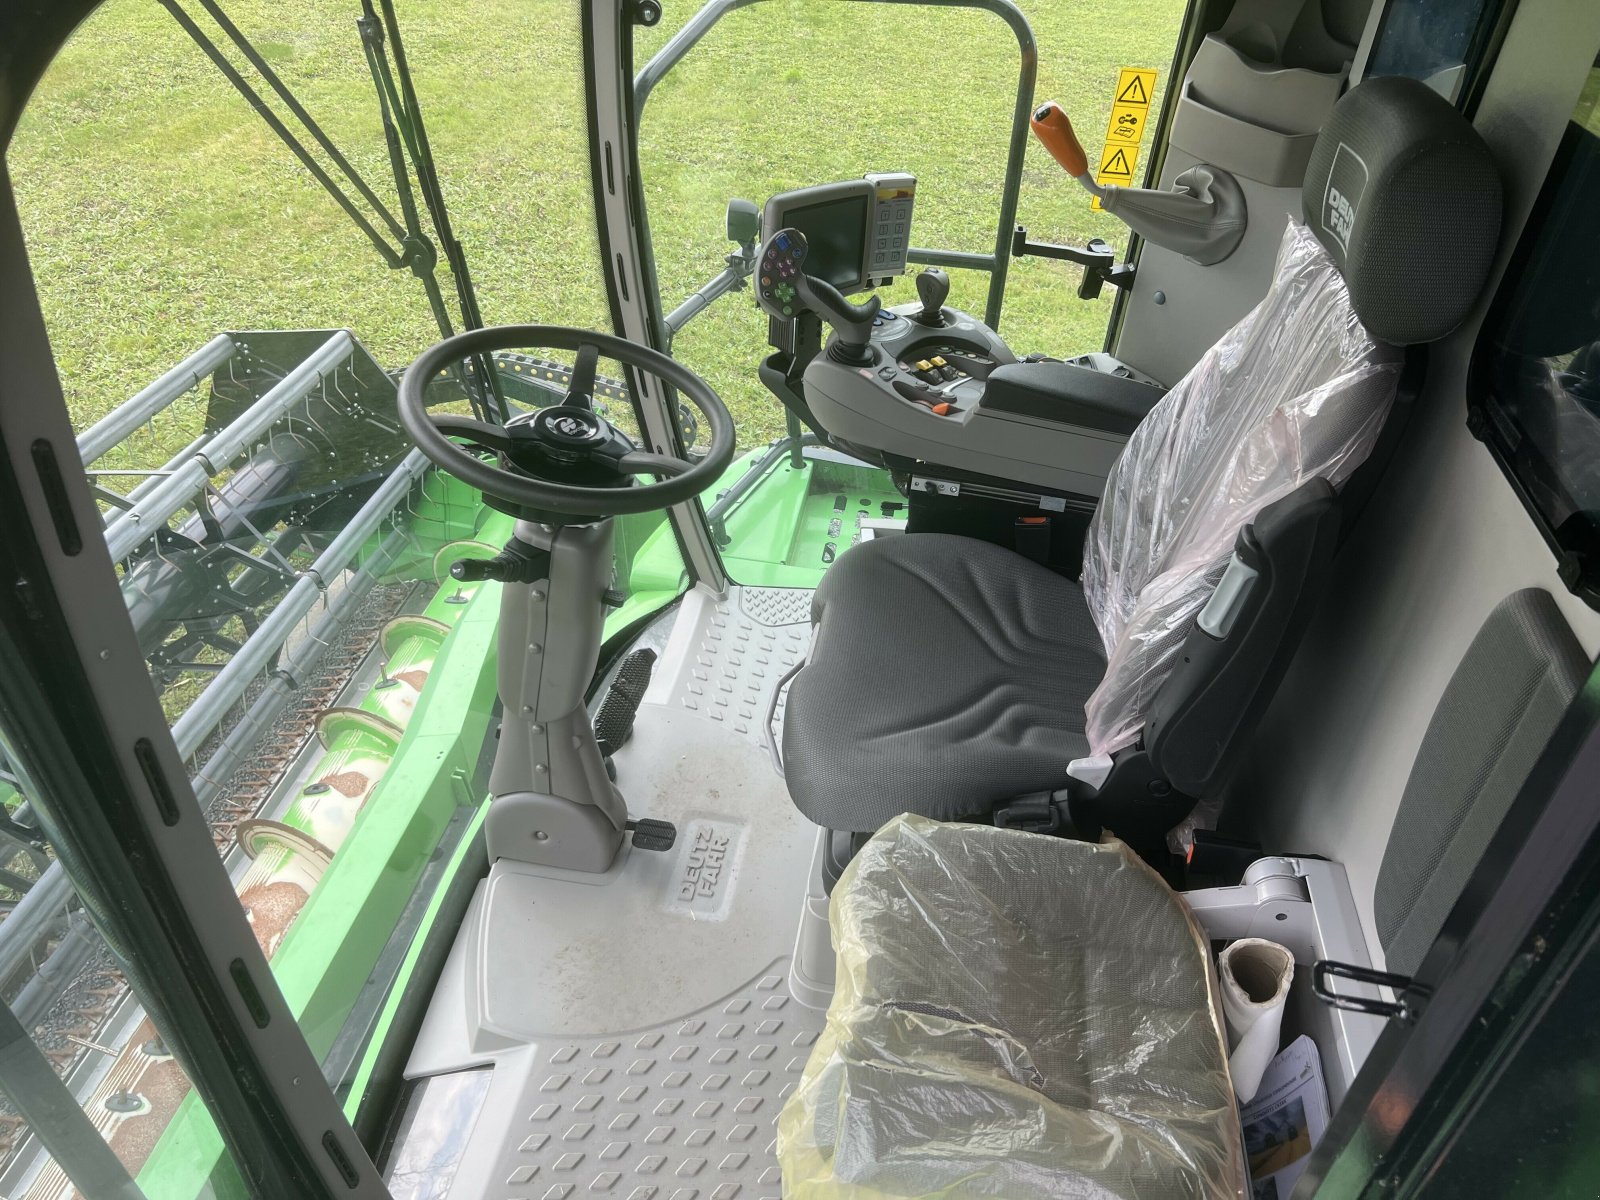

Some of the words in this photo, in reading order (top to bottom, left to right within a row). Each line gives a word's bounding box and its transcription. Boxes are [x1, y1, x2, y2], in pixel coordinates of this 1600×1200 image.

[1328, 187, 1355, 226] DEU
[1330, 209, 1353, 250] FAH
[677, 824, 715, 902] DEUTZ
[697, 835, 731, 899] FAHR
